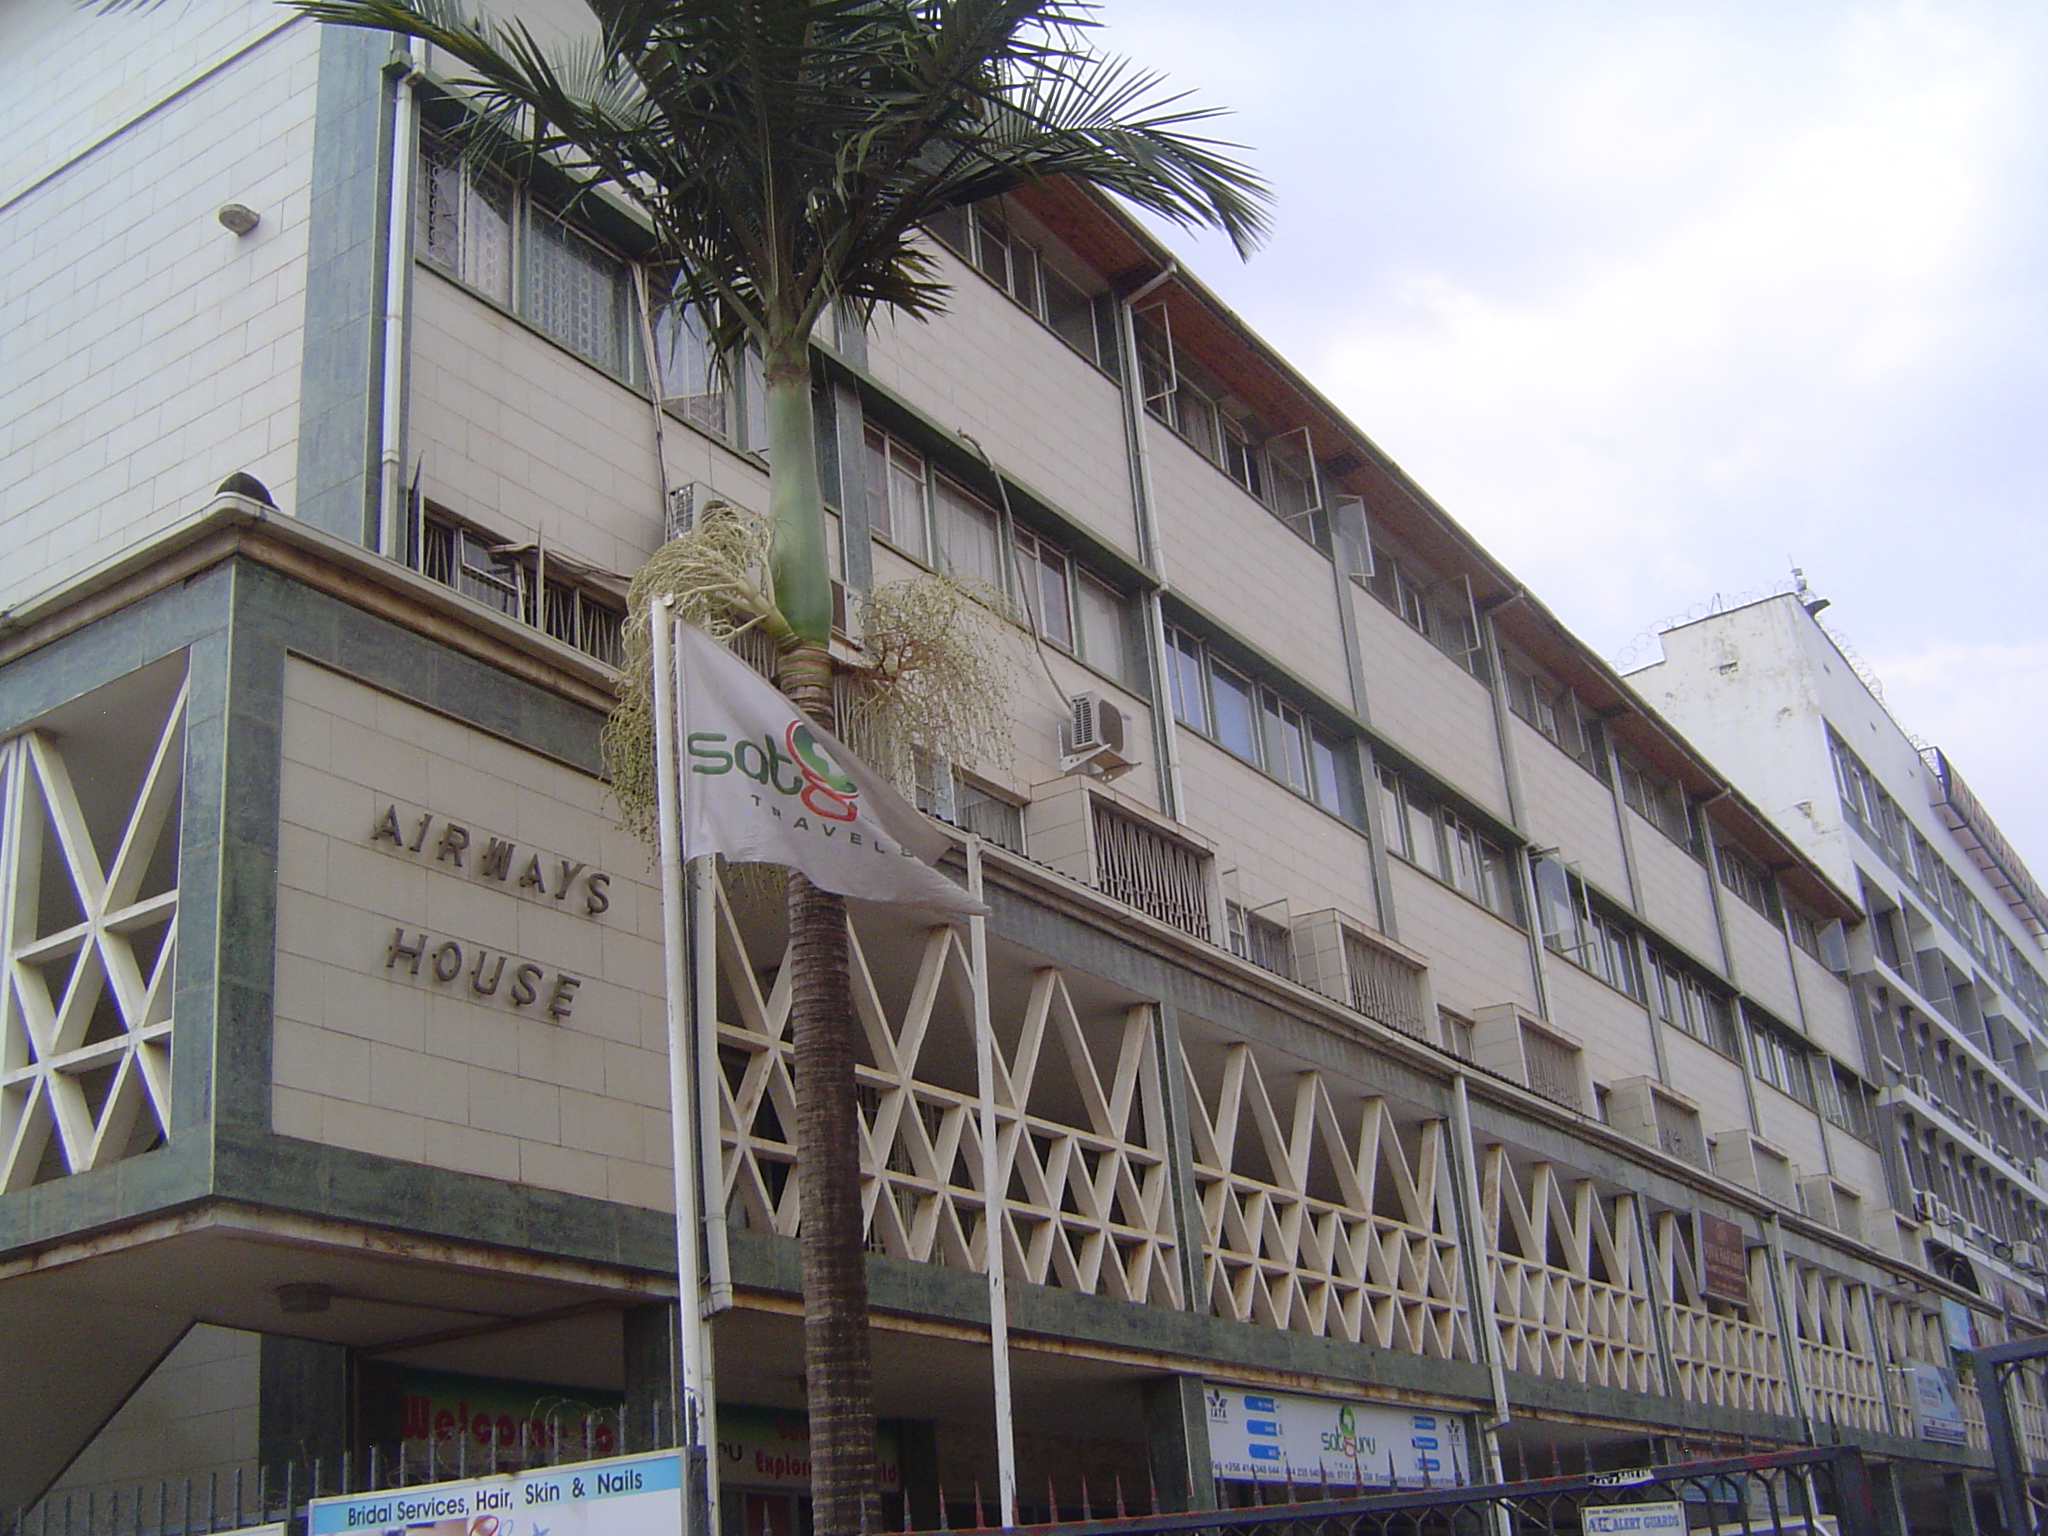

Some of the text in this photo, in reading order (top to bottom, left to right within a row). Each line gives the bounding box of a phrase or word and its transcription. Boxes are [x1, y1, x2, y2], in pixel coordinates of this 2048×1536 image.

[370, 803, 611, 914] AIRWAYS
[386, 927, 582, 1020] HOUSE
[582, 1410, 613, 1452] o
[1320, 1424, 1376, 1457] satguru
[348, 1469, 643, 1526] Bridal Services, Hair, Skin & Nails
[1613, 1517, 1641, 1531] ALERT
[1643, 1514, 1680, 1529] GUARDS
